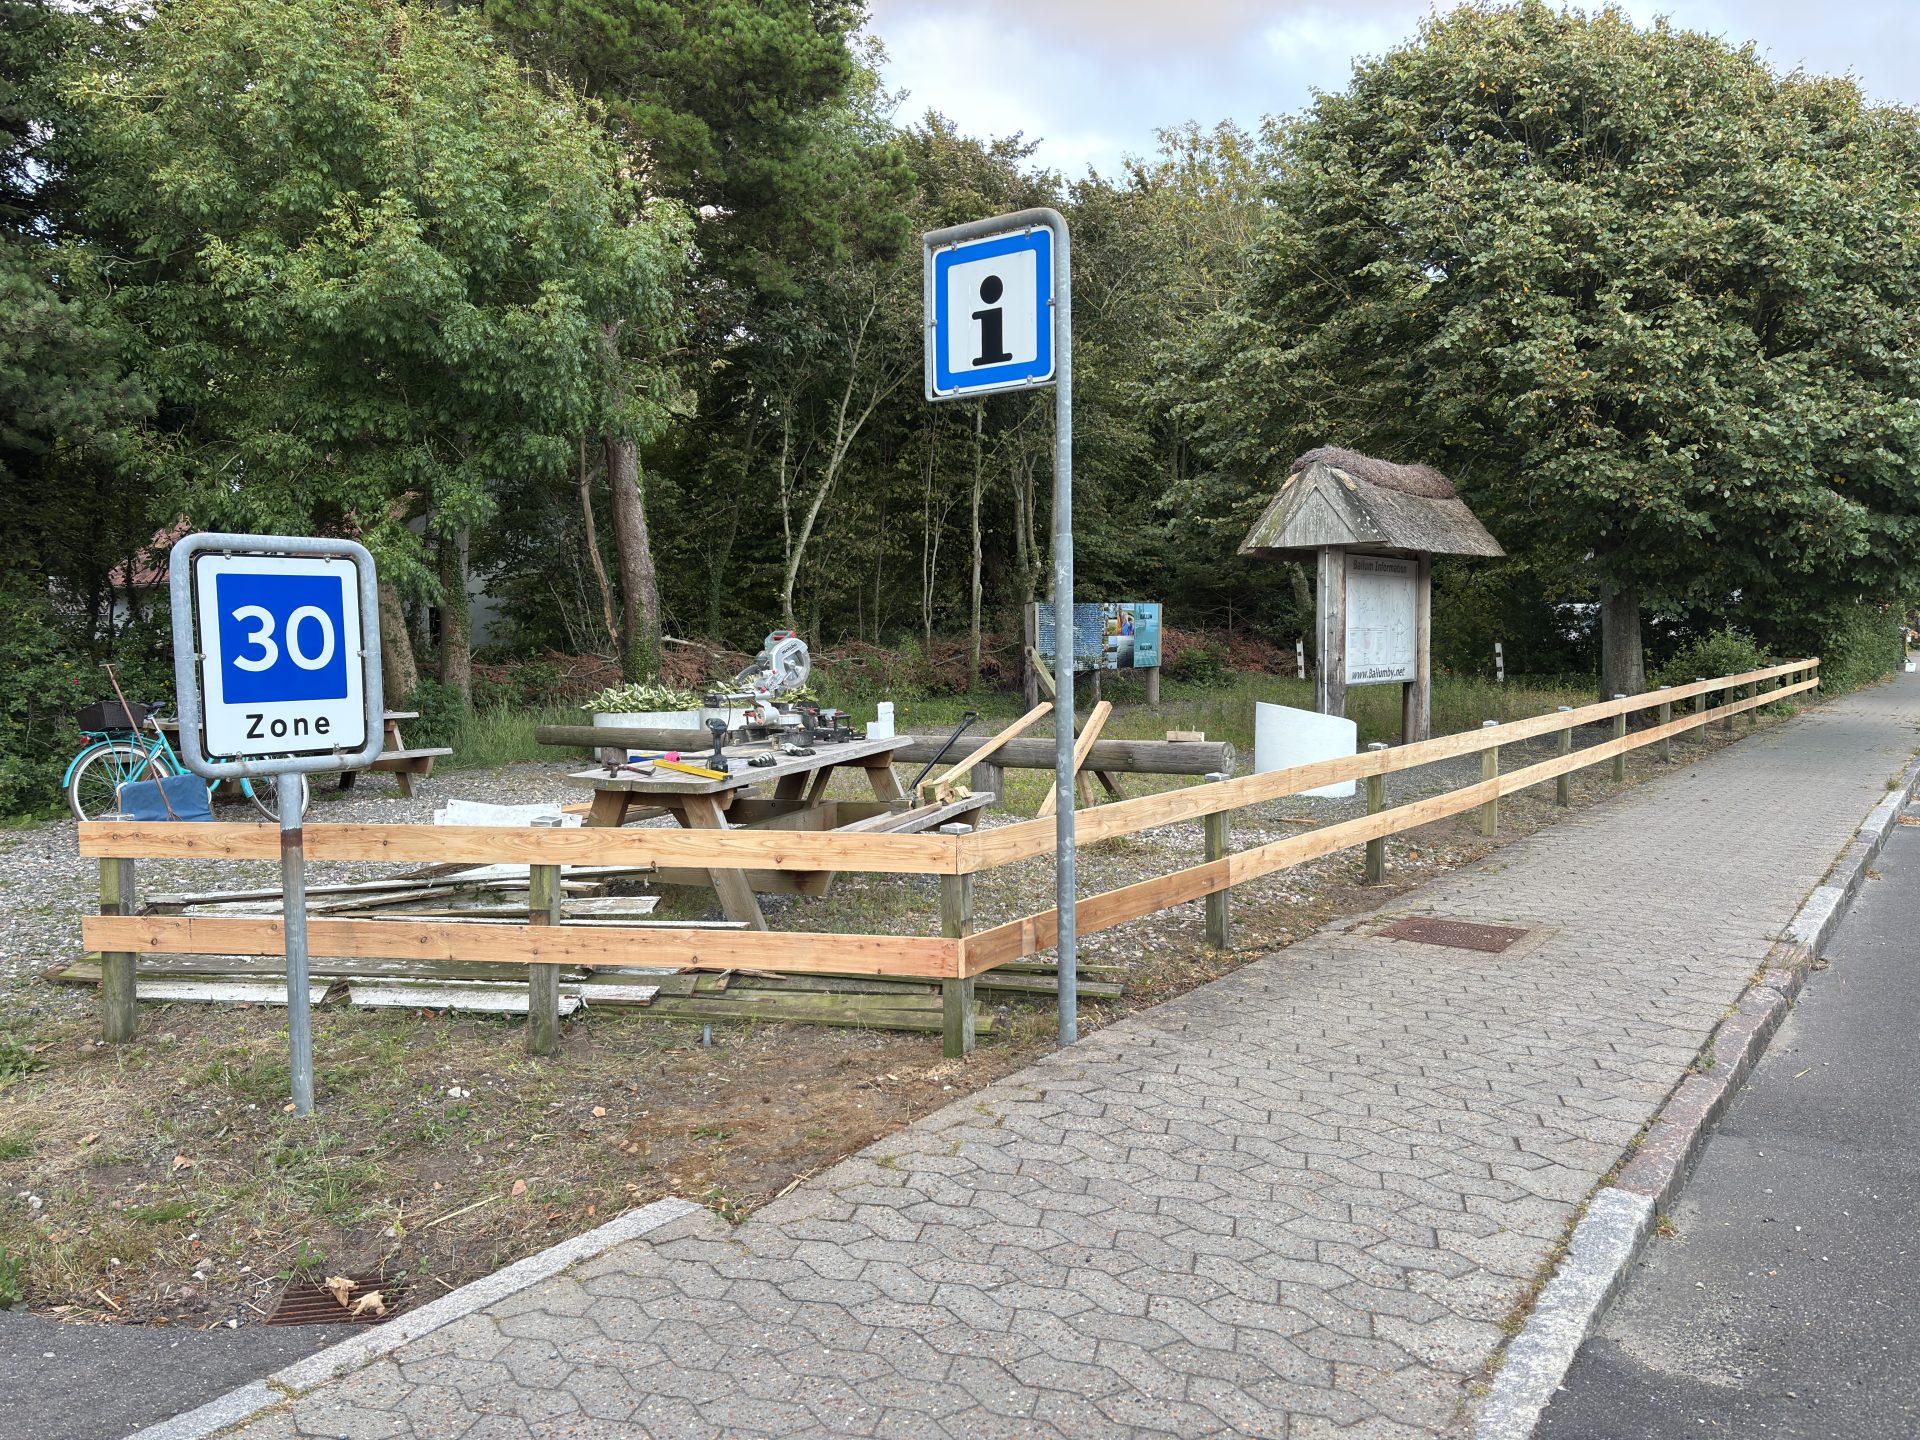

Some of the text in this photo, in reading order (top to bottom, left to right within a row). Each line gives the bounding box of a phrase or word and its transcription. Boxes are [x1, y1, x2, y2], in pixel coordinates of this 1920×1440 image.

[972, 275, 1013, 366] i
[1353, 560, 1374, 571] Ballum
[232, 605, 335, 672] 30
[1352, 667, 1405, 680] www.Ballumby.net
[246, 714, 330, 739] Zone
